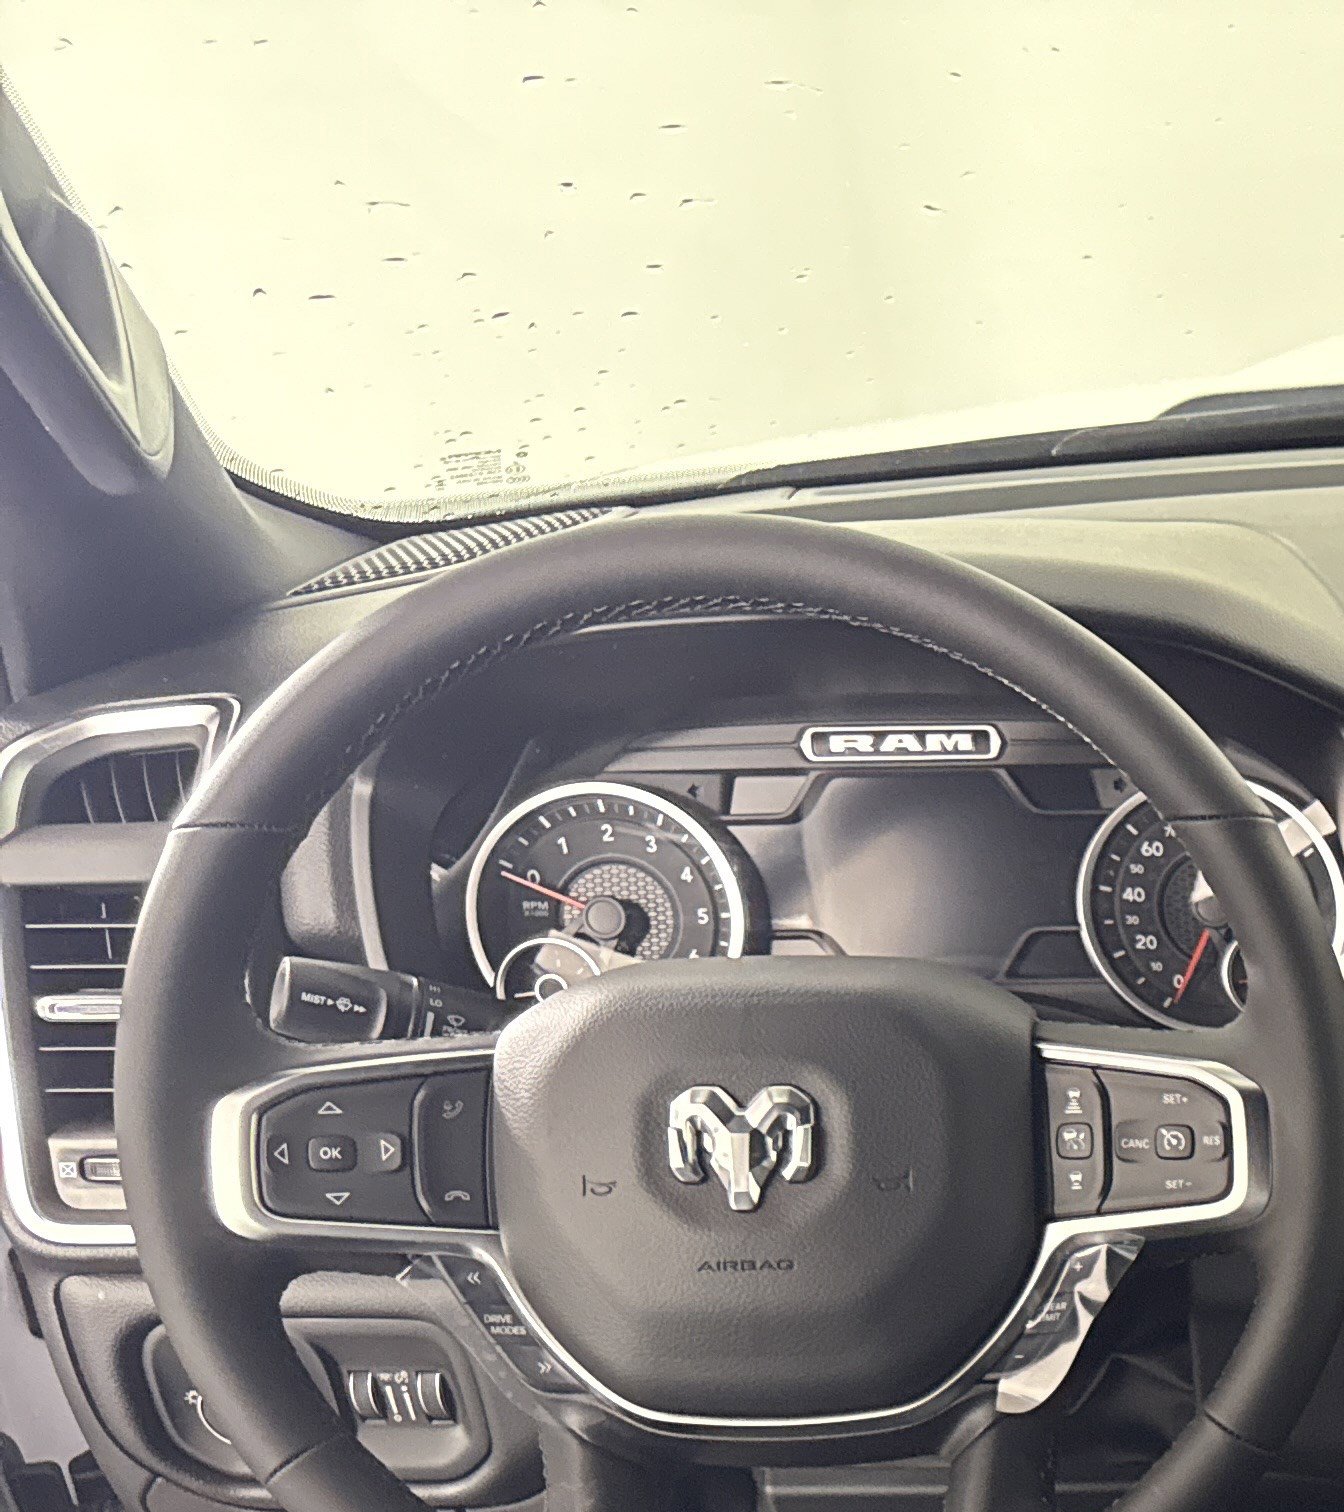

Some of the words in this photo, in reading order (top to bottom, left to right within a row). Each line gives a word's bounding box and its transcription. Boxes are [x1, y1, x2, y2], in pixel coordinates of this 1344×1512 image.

[828, 733, 976, 753] RAM
[600, 824, 614, 841] 2
[557, 837, 568, 854] 1
[645, 835, 657, 853] 3
[1140, 841, 1164, 857] 60
[681, 866, 693, 883] 4
[1129, 864, 1145, 874] 50
[526, 869, 541, 885] 0
[1122, 887, 1146, 903] 40
[523, 902, 549, 910] RPM
[697, 908, 709, 925] 5
[1125, 915, 1140, 925] 30
[1135, 935, 1157, 950] 20
[1151, 961, 1163, 972] 10
[1173, 974, 1185, 989] 0
[301, 991, 326, 1006] MIST
[429, 998, 442, 1008] LO
[1121, 1138, 1150, 1149] CANC
[1203, 1135, 1221, 1146] RES
[319, 1146, 342, 1160] OK
[698, 1259, 796, 1273] AIRBAG
[484, 1313, 513, 1324] DRIVE
[490, 1325, 527, 1336] MODES
